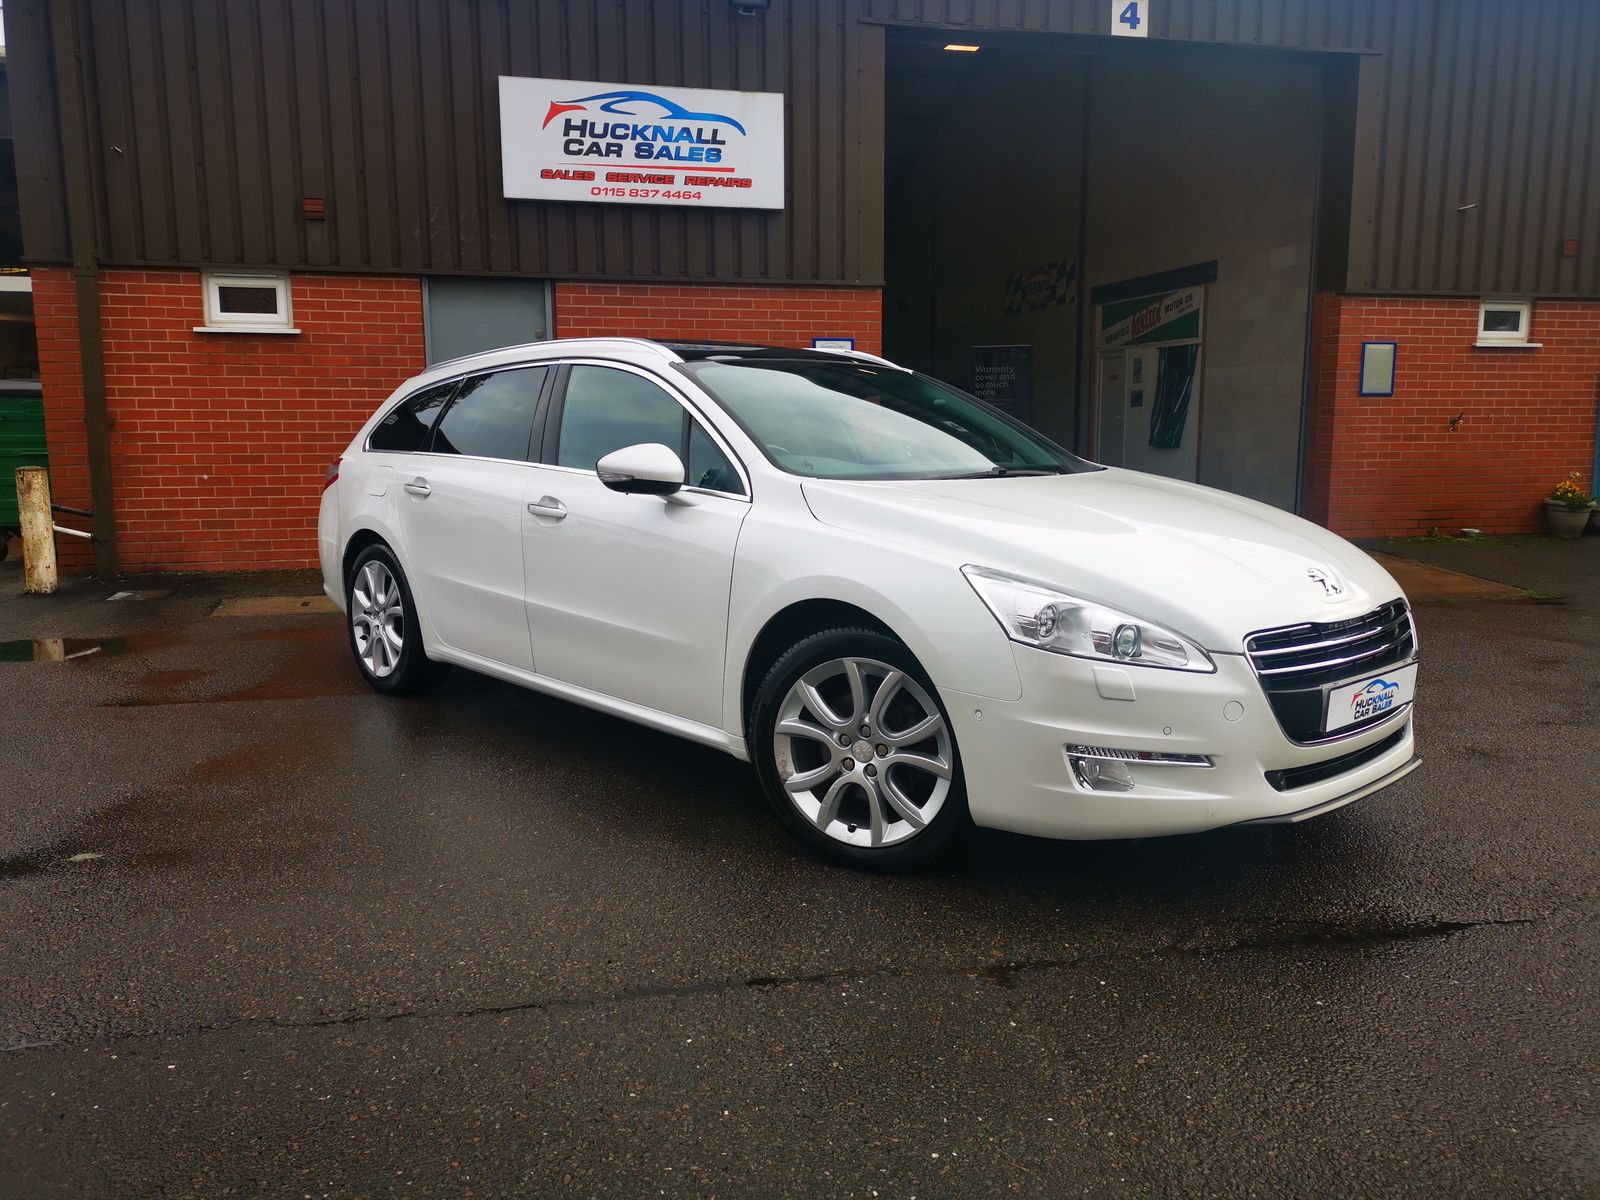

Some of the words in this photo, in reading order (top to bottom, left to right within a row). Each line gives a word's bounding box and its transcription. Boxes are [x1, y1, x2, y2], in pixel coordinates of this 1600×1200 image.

[1119, 1, 1141, 30] 4
[563, 118, 726, 145] HUCKNALL
[563, 138, 624, 158] CAR
[634, 142, 722, 163] SALES
[540, 168, 596, 182] SALES
[605, 172, 675, 185] SERVICE
[684, 175, 752, 189] REPAIRS
[590, 187, 625, 197] 0115
[629, 188, 659, 199] 837
[662, 189, 702, 201] 4464
[1165, 297, 1184, 314] MOTOR
[975, 365, 1014, 374] Warranty
[999, 372, 1016, 380] and
[986, 380, 1009, 388] much
[1353, 708, 1370, 720] CAR
[1371, 700, 1393, 713] SALES
[1355, 690, 1393, 710] HUCKNALL
